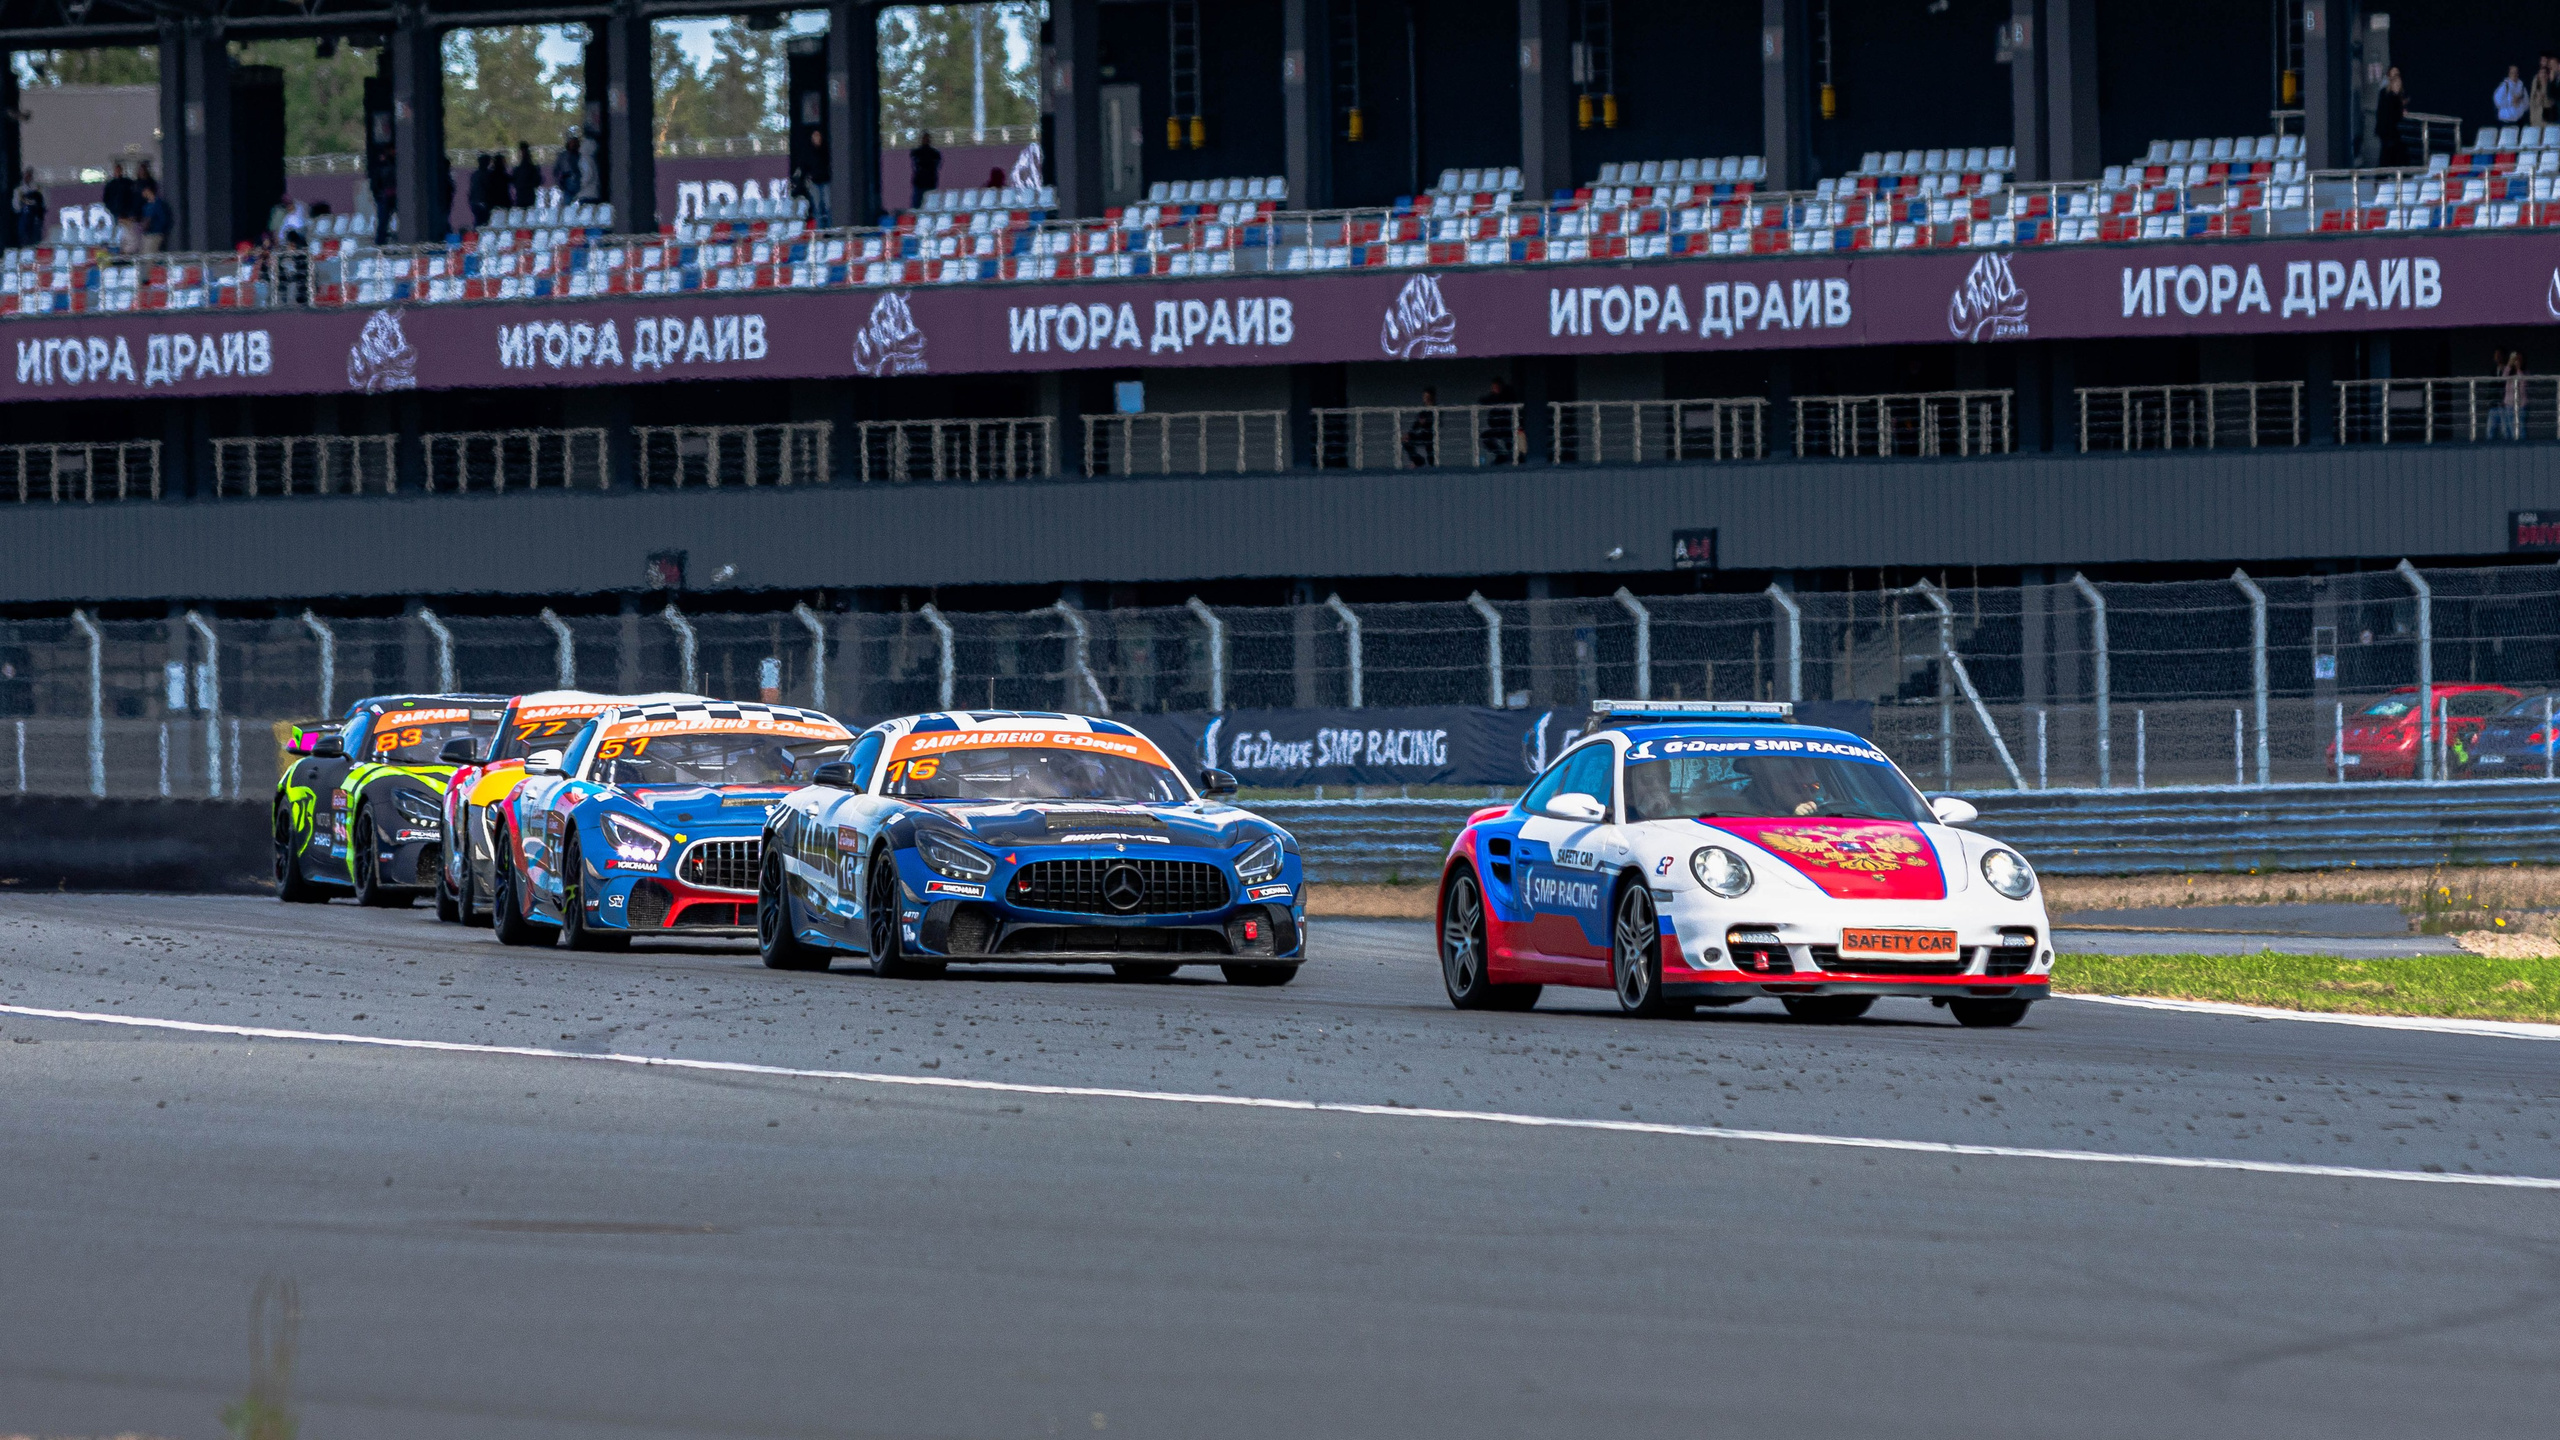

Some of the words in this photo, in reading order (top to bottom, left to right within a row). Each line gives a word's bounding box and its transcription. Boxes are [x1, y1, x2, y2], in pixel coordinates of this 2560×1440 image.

[2121, 264, 2271, 317] ИГОРА
[2282, 257, 2442, 318] ДРАЙВ
[1550, 285, 1690, 336] ИГОРА
[1700, 278, 1851, 338] ДРАЙВ
[1008, 302, 1142, 353] ИГОРА
[498, 318, 624, 369] ИГОРА
[17, 336, 137, 386] ИГОРА
[516, 721, 567, 741] 77
[625, 719, 750, 736] ЗАПРАВЛЕНО
[376, 728, 423, 753] 83
[598, 738, 651, 759] 51
[911, 732, 1045, 751] ЗАПРАВЛЕНО
[1316, 728, 1363, 768] SMP
[1367, 728, 1448, 767] RACING
[1754, 739, 1803, 751] SMP
[1807, 741, 1885, 763] RACING
[887, 758, 940, 782] 16
[1098, 832, 1171, 844] AMG
[617, 862, 658, 872] YOKOHAMA
[1557, 848, 1578, 865] SAFETY
[1580, 851, 1594, 867] CAR
[840, 854, 855, 892] 16
[1534, 878, 1556, 904] SMP
[1559, 881, 1598, 909] RACING
[1847, 934, 1914, 950] SAFETY
[1918, 936, 1953, 950] CAR
